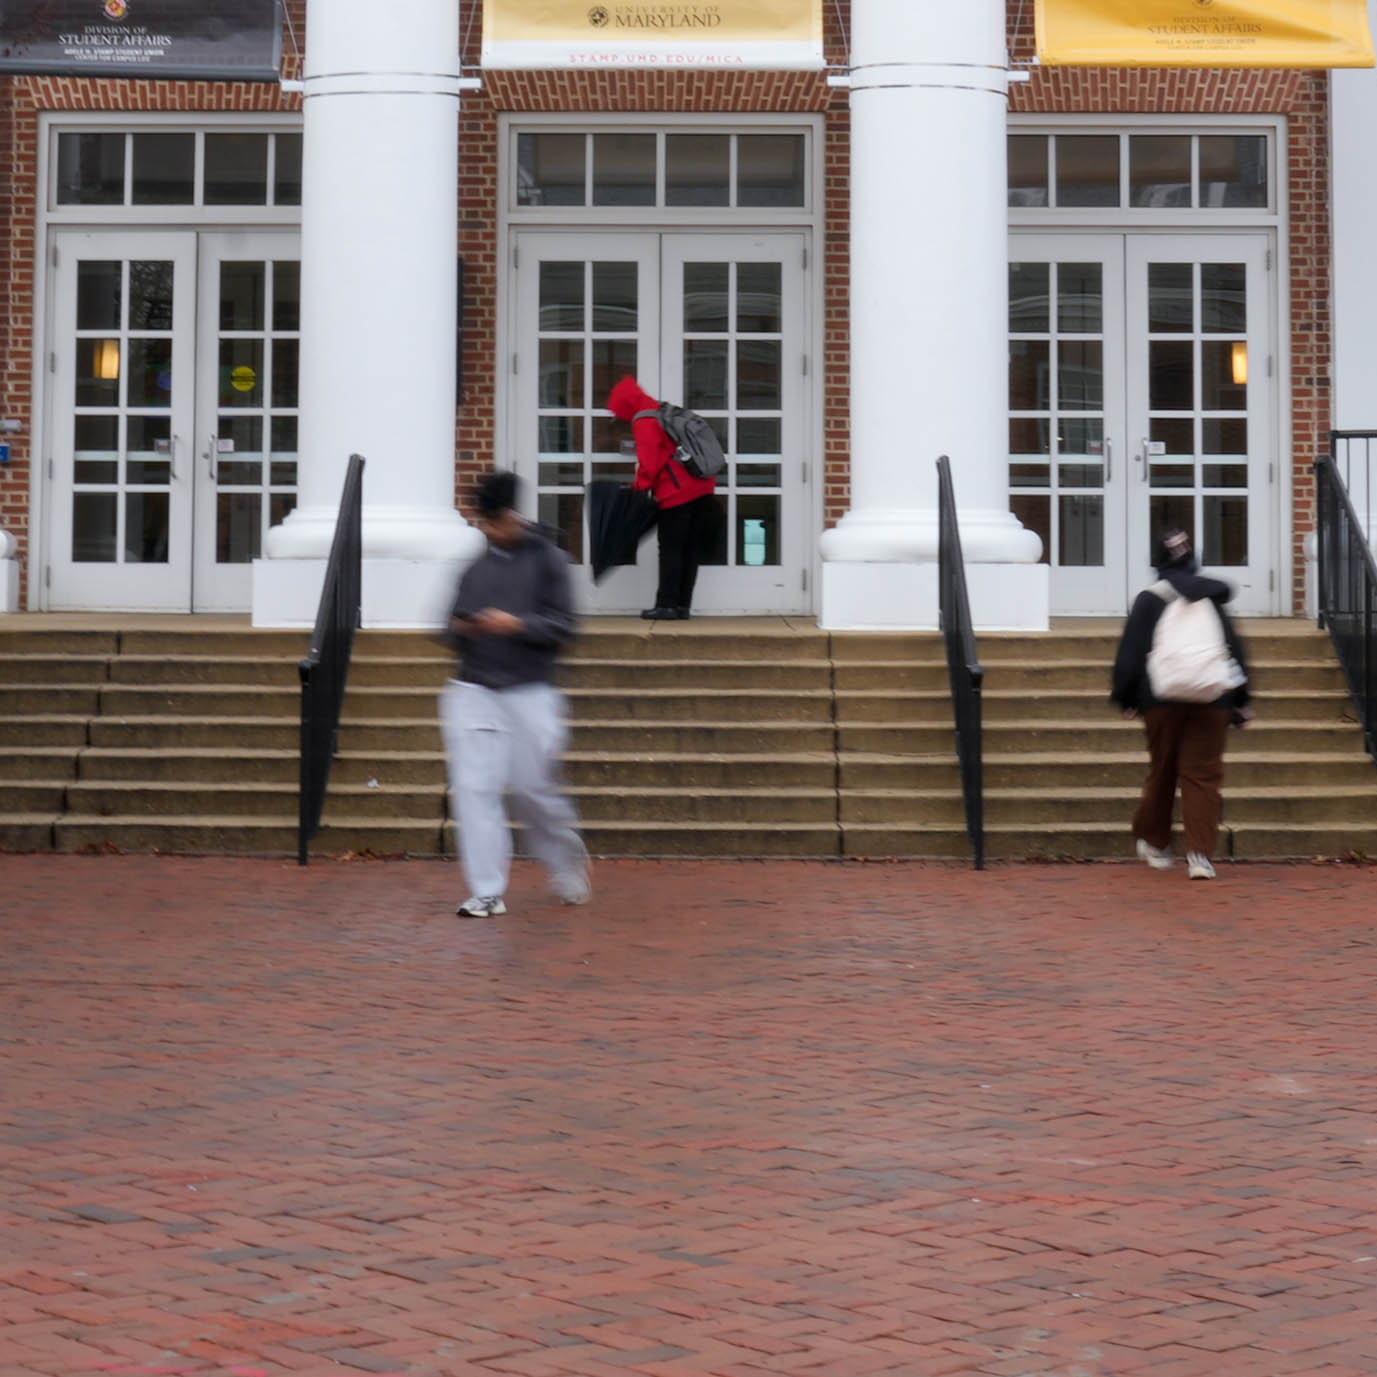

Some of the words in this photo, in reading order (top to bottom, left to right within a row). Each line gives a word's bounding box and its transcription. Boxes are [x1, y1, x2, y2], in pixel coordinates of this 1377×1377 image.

[615, 5, 698, 13] UNIVERSITY
[704, 5, 720, 13] OF
[615, 14, 722, 28] MARYLAND
[84, 25, 130, 35] DIVISION
[133, 26, 148, 35] OF
[1146, 23, 1209, 34] STUDENT
[1211, 23, 1264, 33] AFFAIRS
[58, 34, 121, 45] STUDENT
[122, 35, 172, 46] AFFAIRS
[569, 53, 745, 64] STAMP.UMD.EDU/MICA
